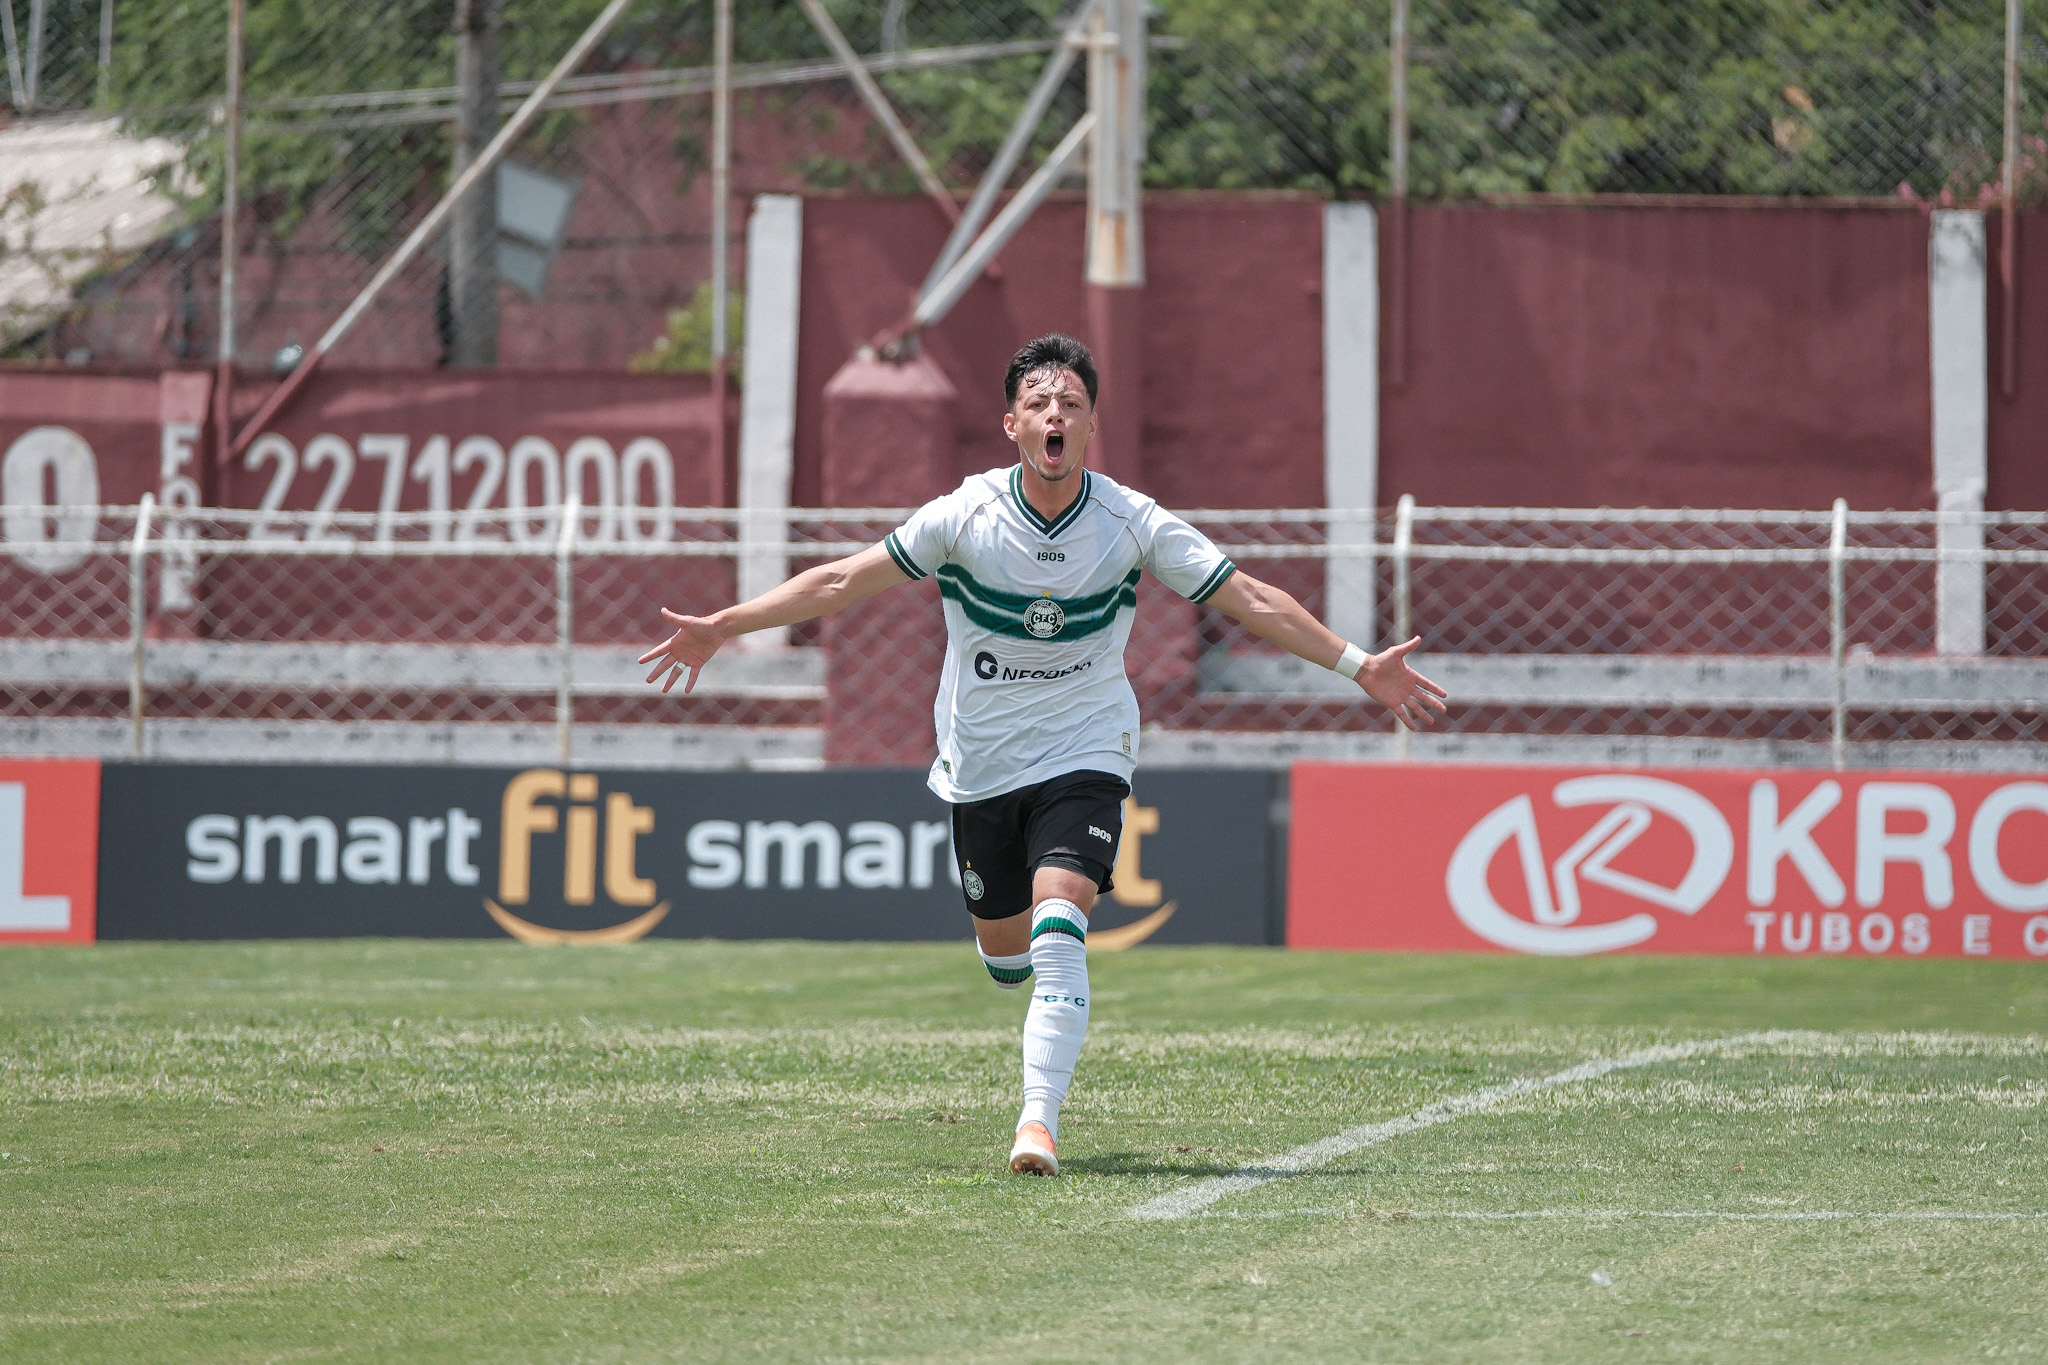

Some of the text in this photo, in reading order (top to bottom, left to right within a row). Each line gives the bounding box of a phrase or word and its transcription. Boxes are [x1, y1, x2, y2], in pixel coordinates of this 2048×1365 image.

[243, 432, 677, 556] 22712000
[1037, 551, 1066, 563] 1909
[1033, 613, 1056, 624] CFC
[185, 768, 657, 906] smart fit
[685, 818, 962, 890] smar
[1088, 824, 1112, 843] 1909
[1746, 911, 1932, 954] TUBOS
[1962, 913, 1992, 955] E
